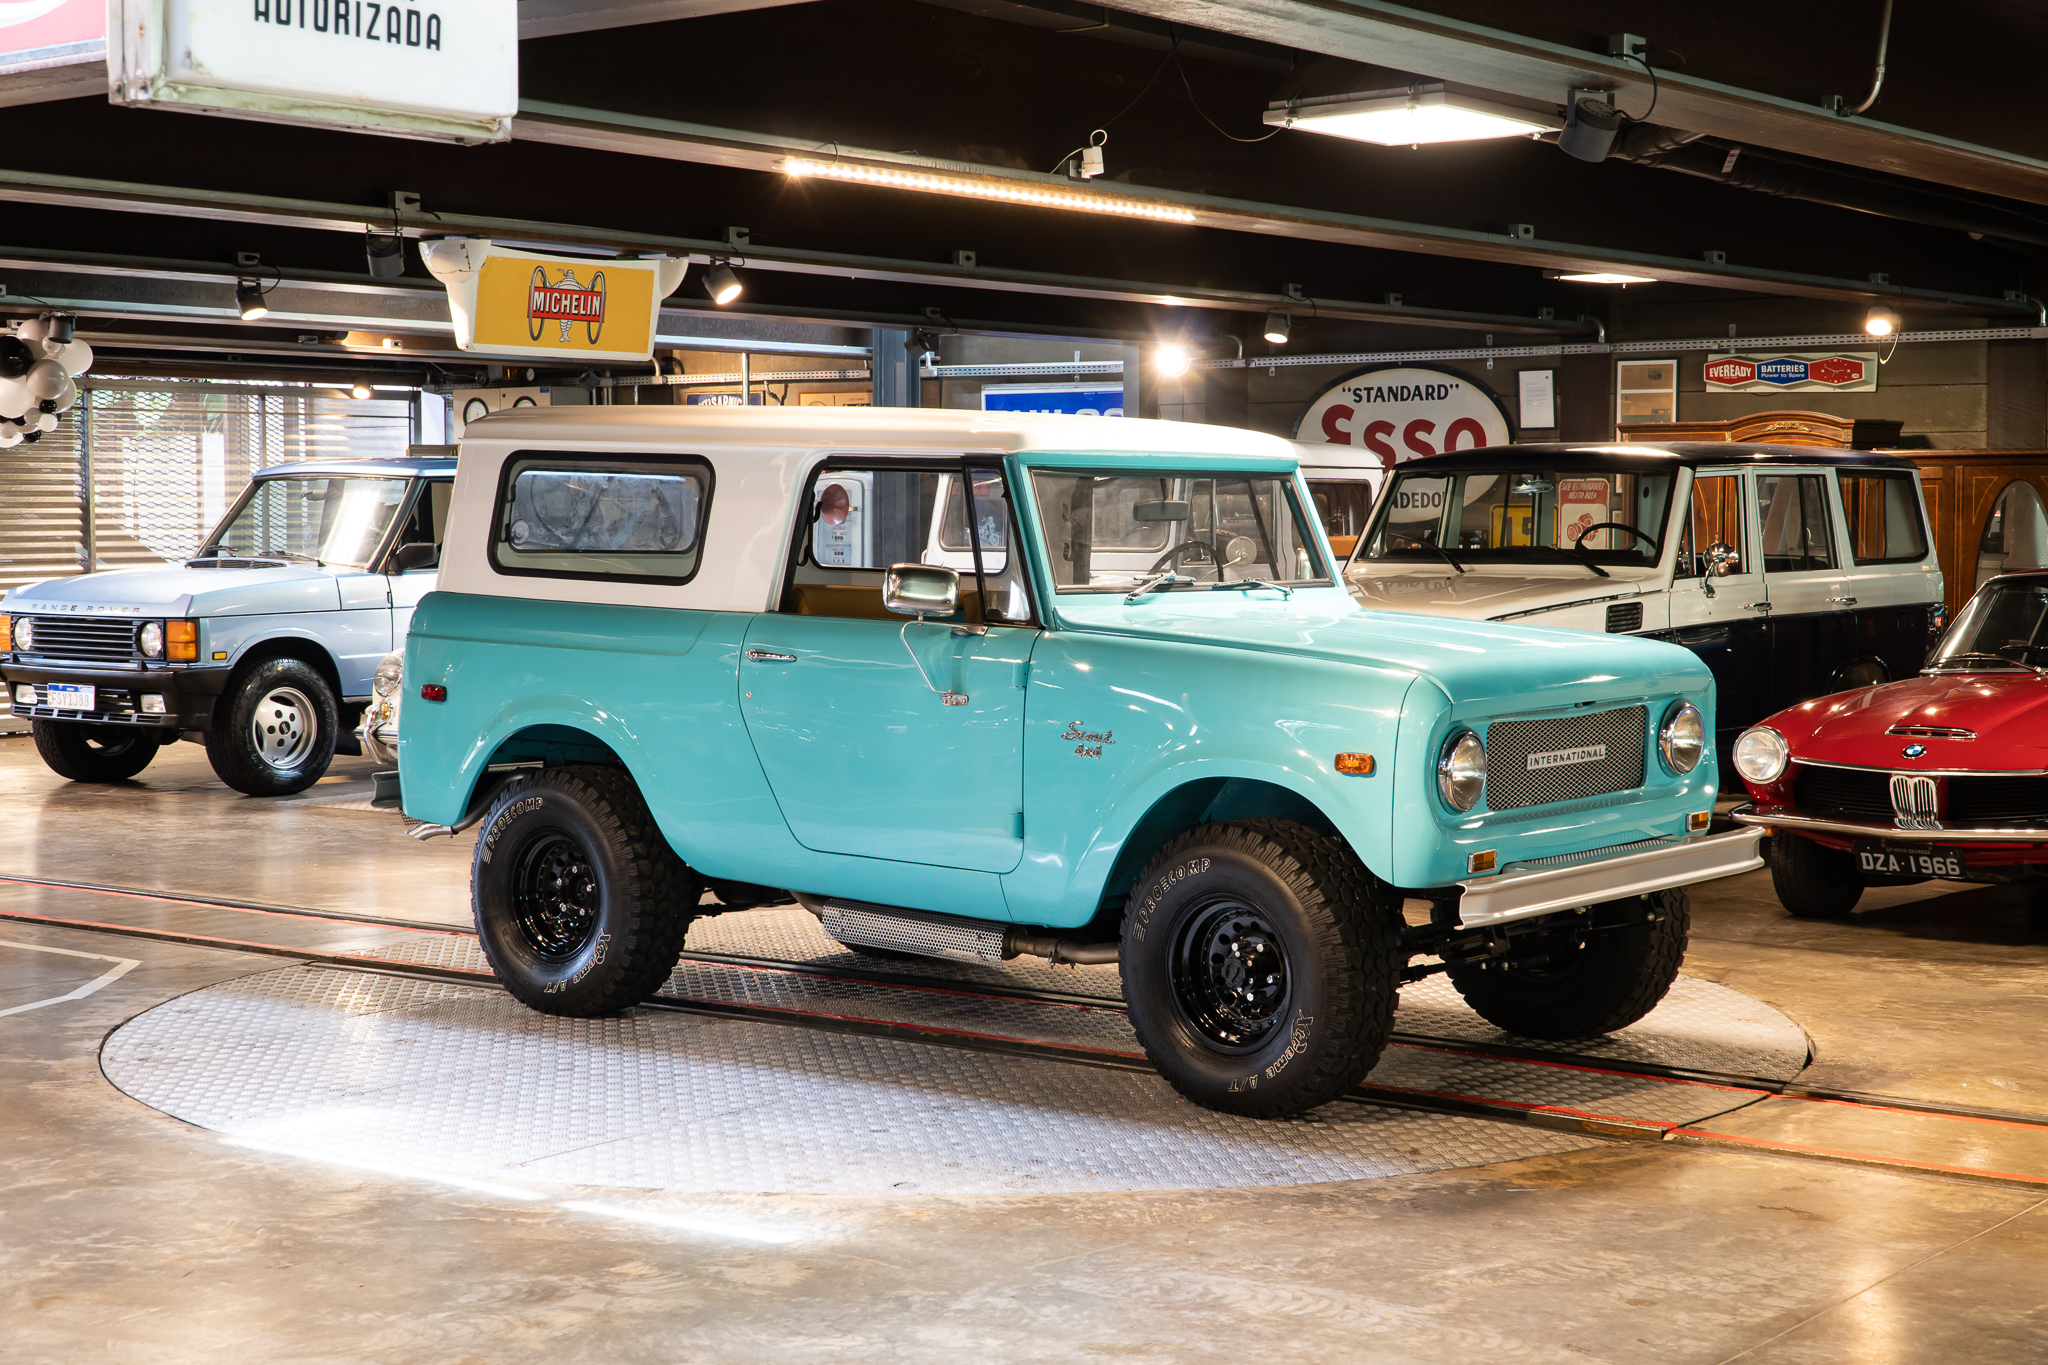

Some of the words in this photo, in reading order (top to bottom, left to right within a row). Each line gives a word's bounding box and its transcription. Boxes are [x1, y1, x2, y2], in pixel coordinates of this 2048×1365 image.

[254, 0, 441, 51] AUTORIZADA
[532, 291, 602, 317] MICHELIN
[1709, 364, 1752, 377] EVEREADY
[1761, 364, 1805, 373] BATTERIES
[31, 603, 78, 612] RANGE
[86, 605, 141, 614] ROVER
[1061, 720, 1116, 744] Scout
[1075, 743, 1102, 759] 4x4
[1530, 748, 1604, 767] INTERNATIONAL
[1227, 1074, 1259, 1093] A/T
